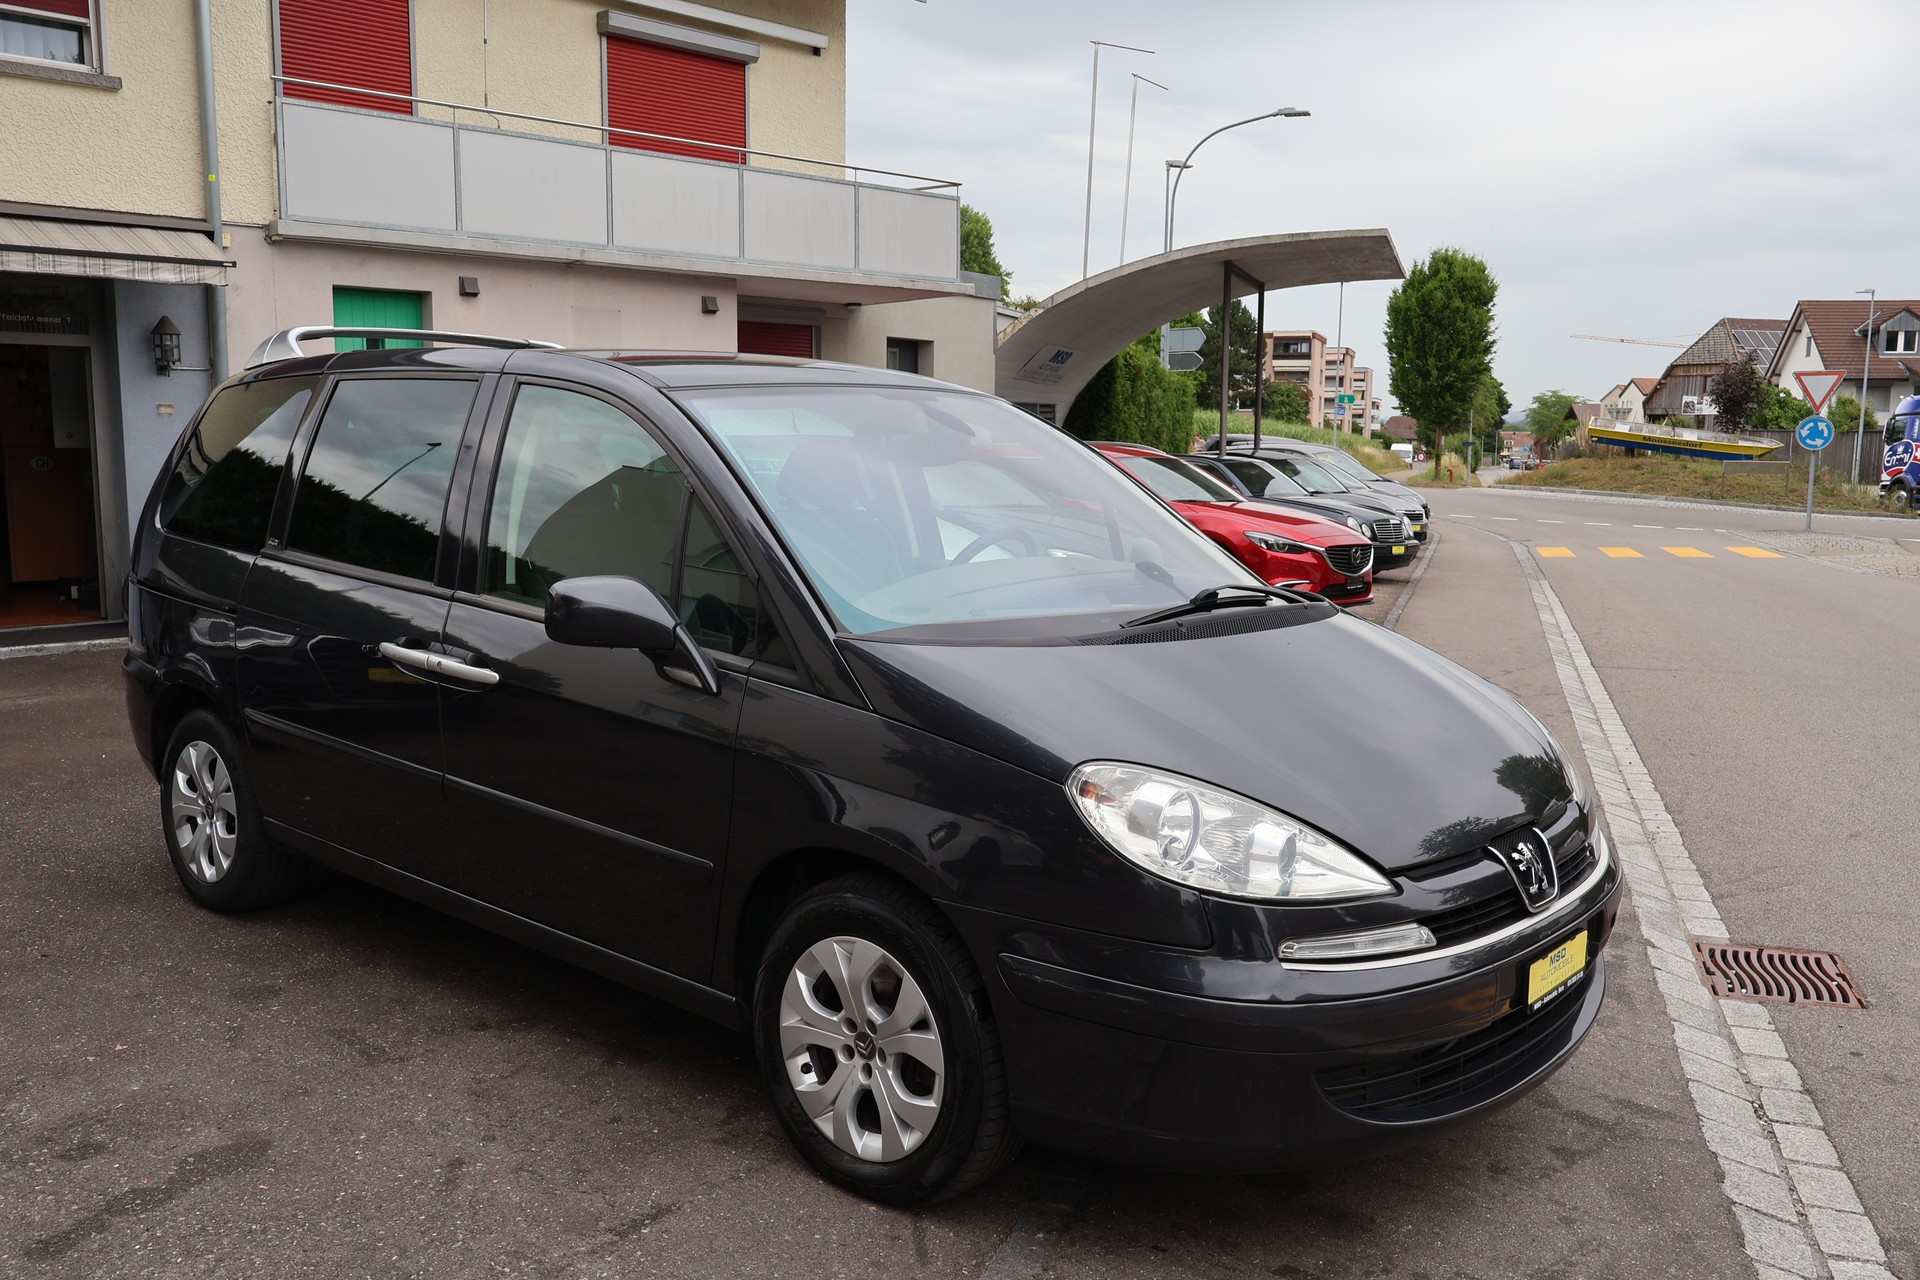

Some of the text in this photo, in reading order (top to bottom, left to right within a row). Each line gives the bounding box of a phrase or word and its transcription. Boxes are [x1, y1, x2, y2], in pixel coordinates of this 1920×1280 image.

[65, 316, 71, 324] 1
[1048, 349, 1073, 365] MSD
[1642, 436, 1704, 449] Moosseedorf
[36, 457, 49, 469] CH
[1549, 947, 1567, 967] MSD
[1541, 954, 1574, 982] AUTOMOBILE
